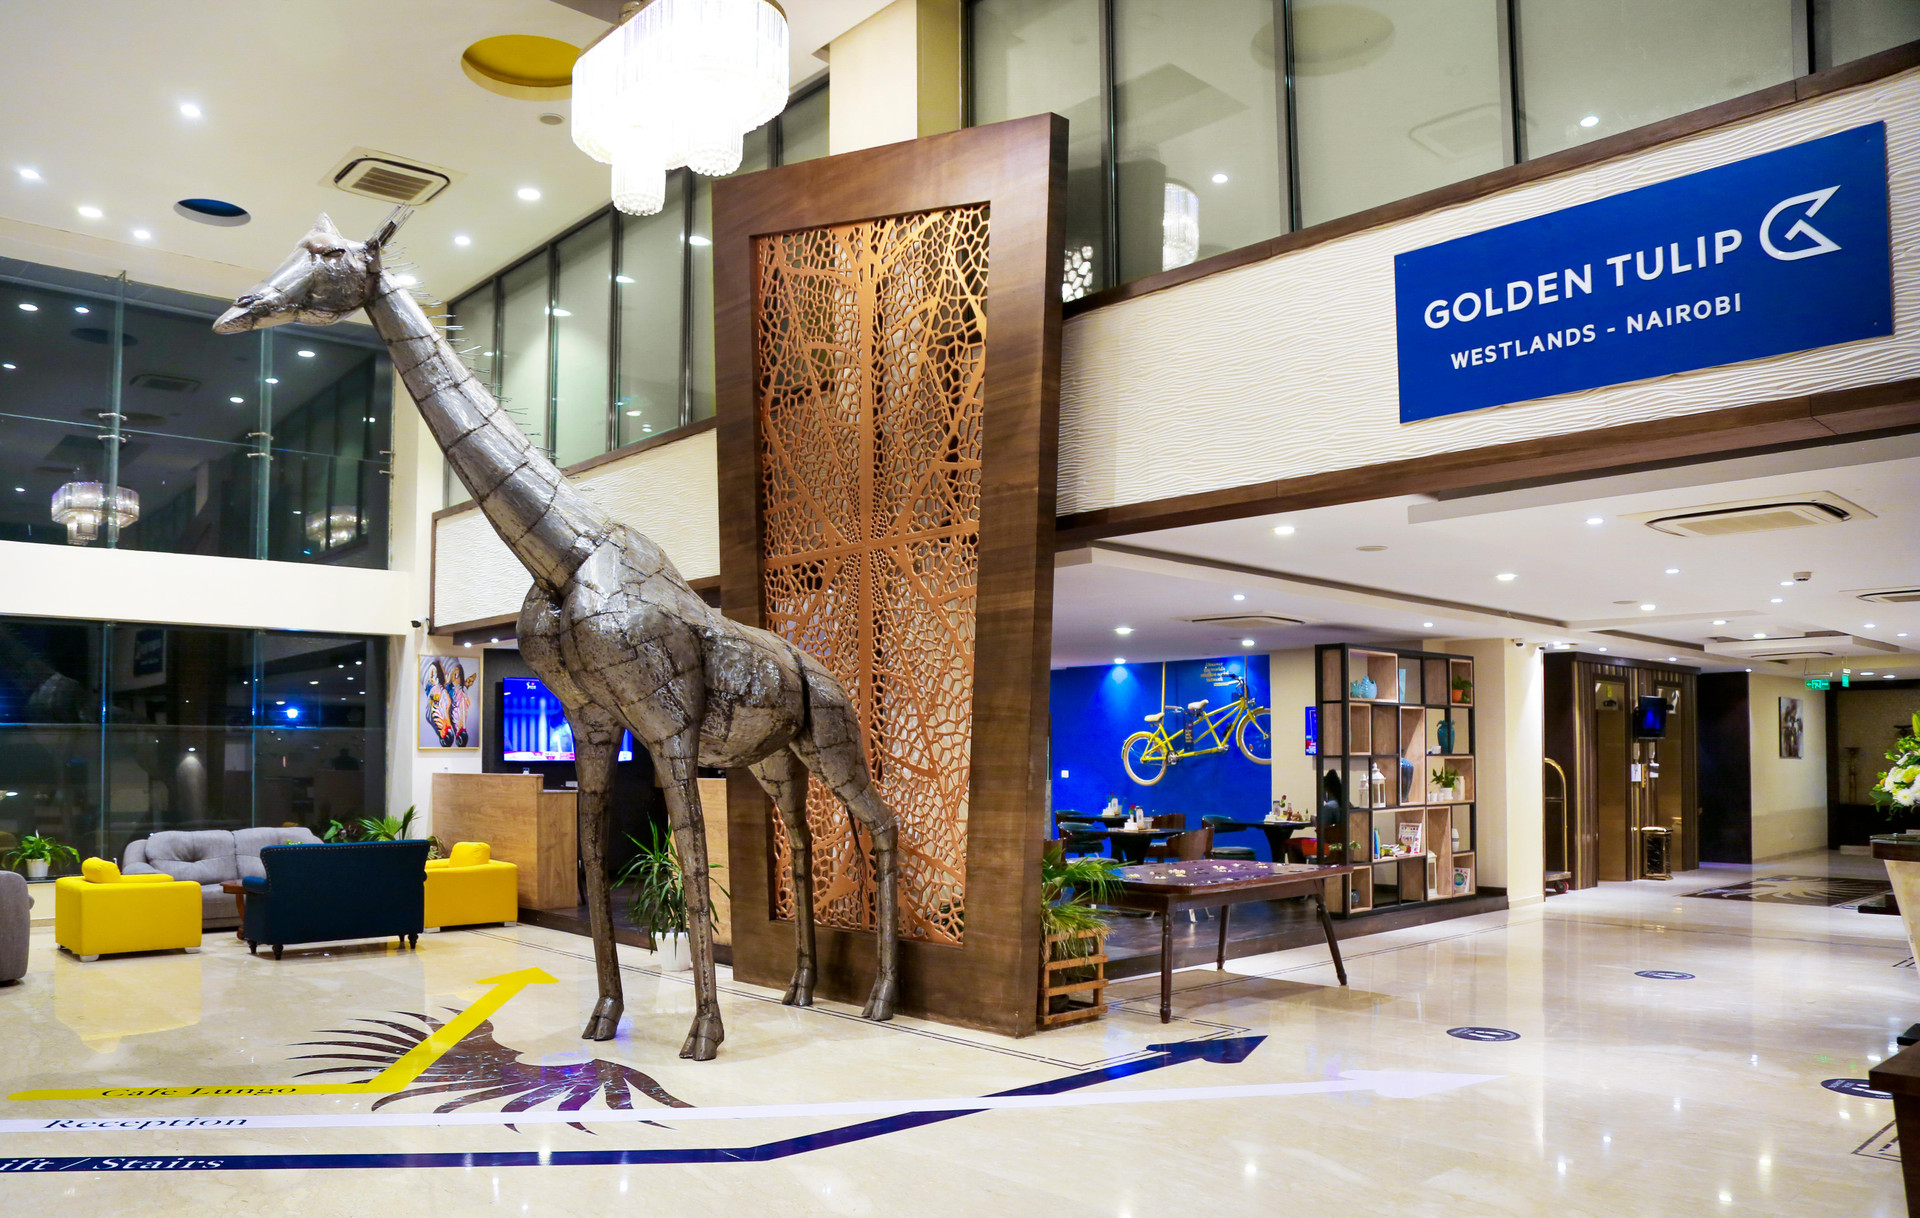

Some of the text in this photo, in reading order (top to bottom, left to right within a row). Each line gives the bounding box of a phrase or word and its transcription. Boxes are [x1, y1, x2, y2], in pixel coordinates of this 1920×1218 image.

[1424, 229, 1743, 329] GOLDEN TULIP
[1450, 324, 1596, 370] WESTLANDS
[1627, 293, 1741, 334] NAIROBI
[189, 1086, 297, 1096] Lungo
[43, 1117, 248, 1130] Reception
[0, 1157, 224, 1171] ift / Stairs
